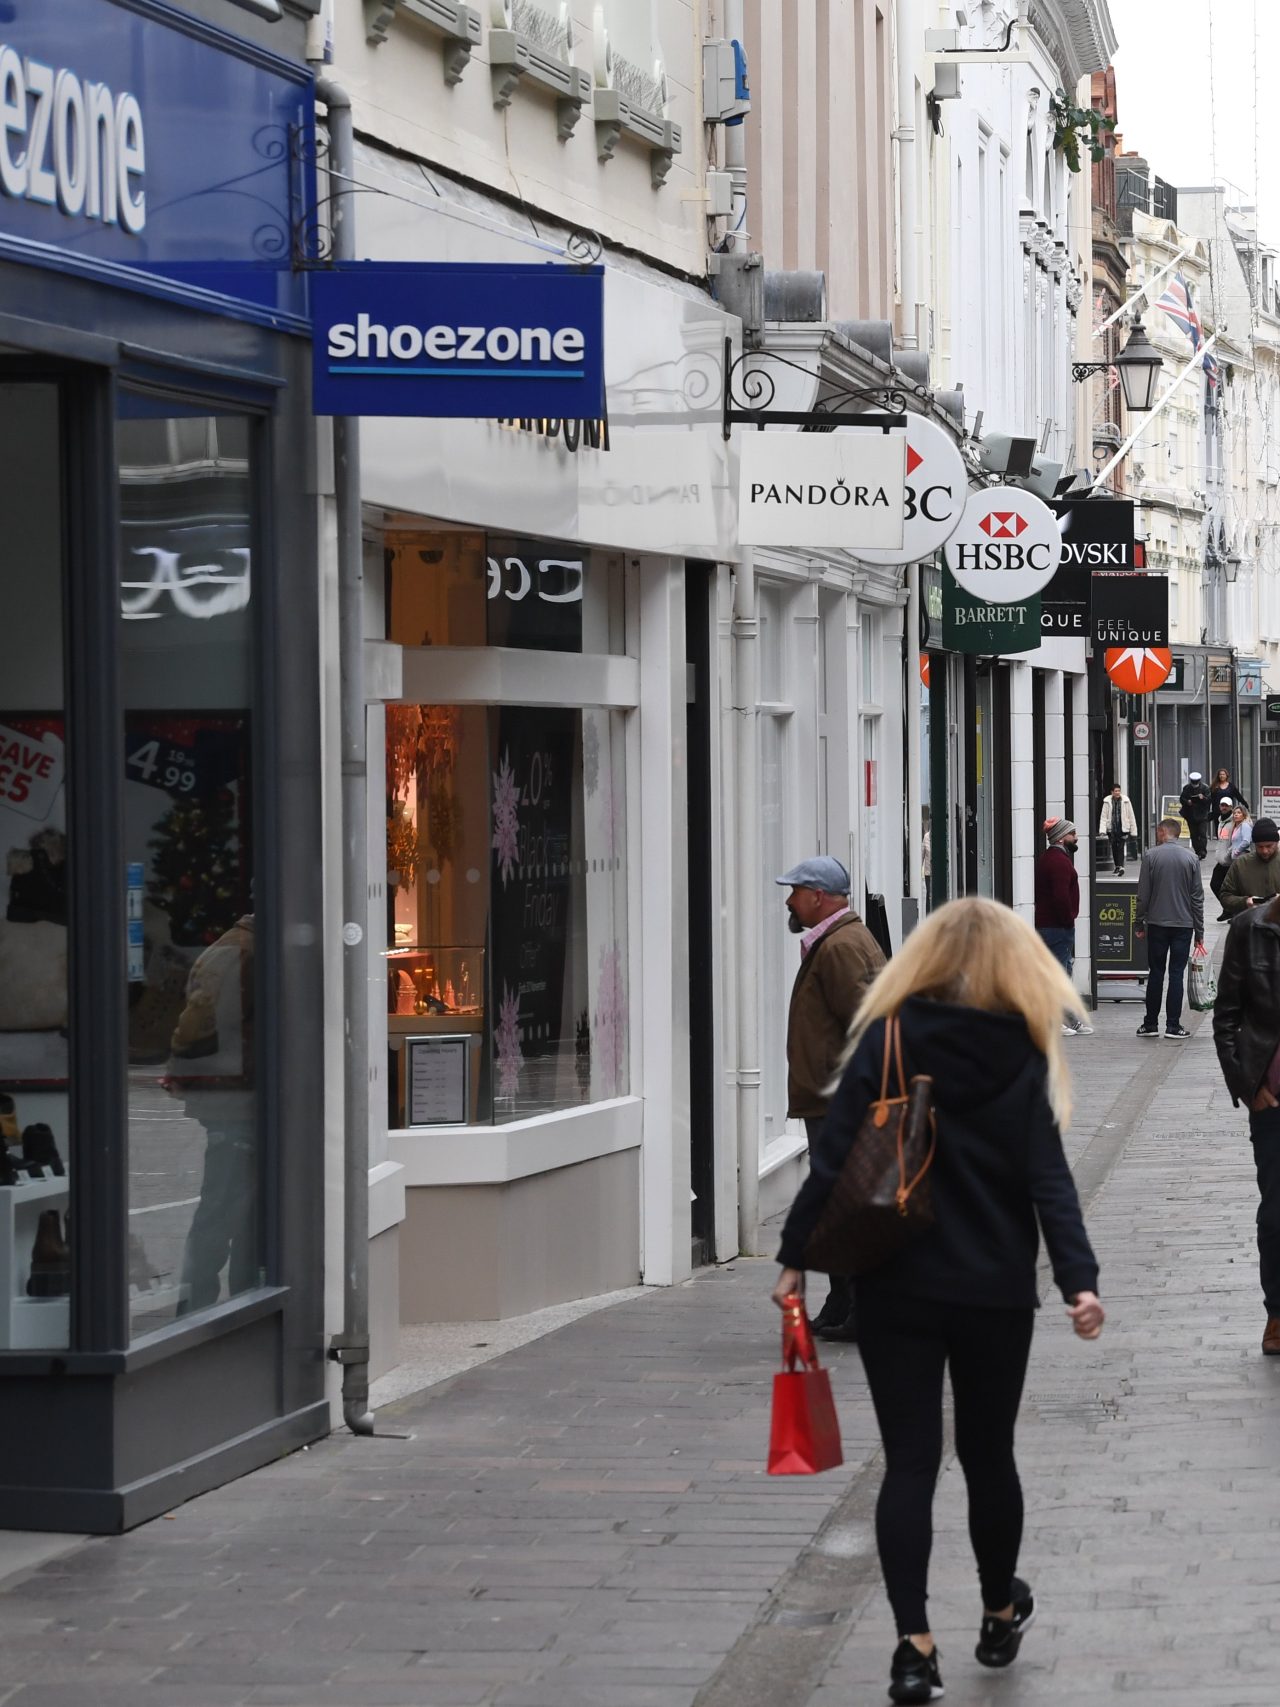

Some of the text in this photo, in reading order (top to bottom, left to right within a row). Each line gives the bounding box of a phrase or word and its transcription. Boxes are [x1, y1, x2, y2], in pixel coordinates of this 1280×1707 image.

[328, 313, 585, 362] shoezone
[751, 480, 890, 507] PANDORA
[956, 543, 1051, 571] HSBC
[954, 606, 1028, 626] BARRETT
[1041, 614, 1083, 628] QUE
[1098, 619, 1134, 630] FEEL
[1098, 631, 1162, 642] UNIQUE
[127, 740, 196, 792] 4.99
